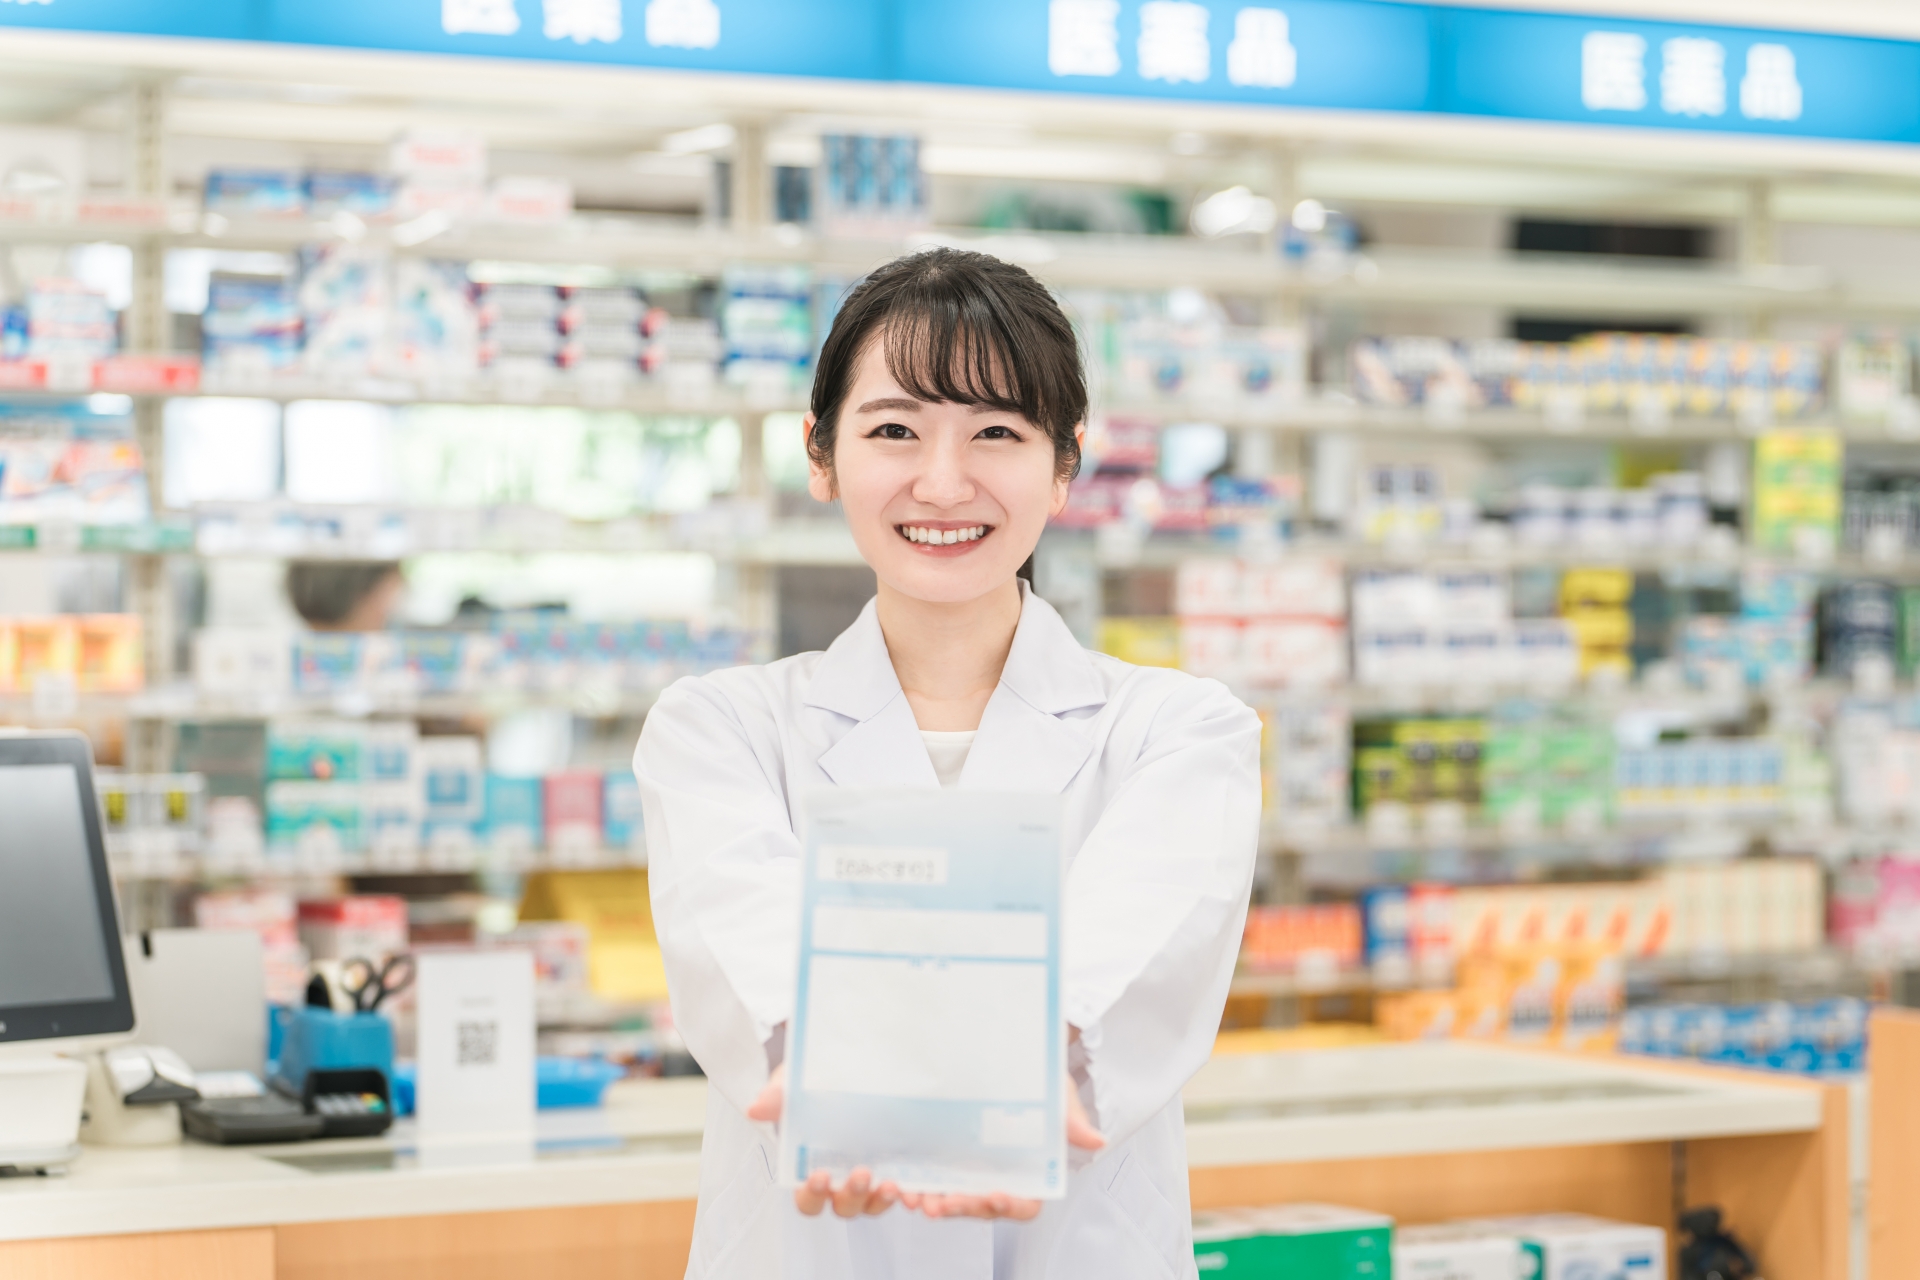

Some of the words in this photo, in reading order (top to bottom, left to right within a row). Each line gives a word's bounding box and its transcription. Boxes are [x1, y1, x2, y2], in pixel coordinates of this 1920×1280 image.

[1047, 0, 1297, 88] 医薬品
[1581, 30, 1803, 121] 医薬品
